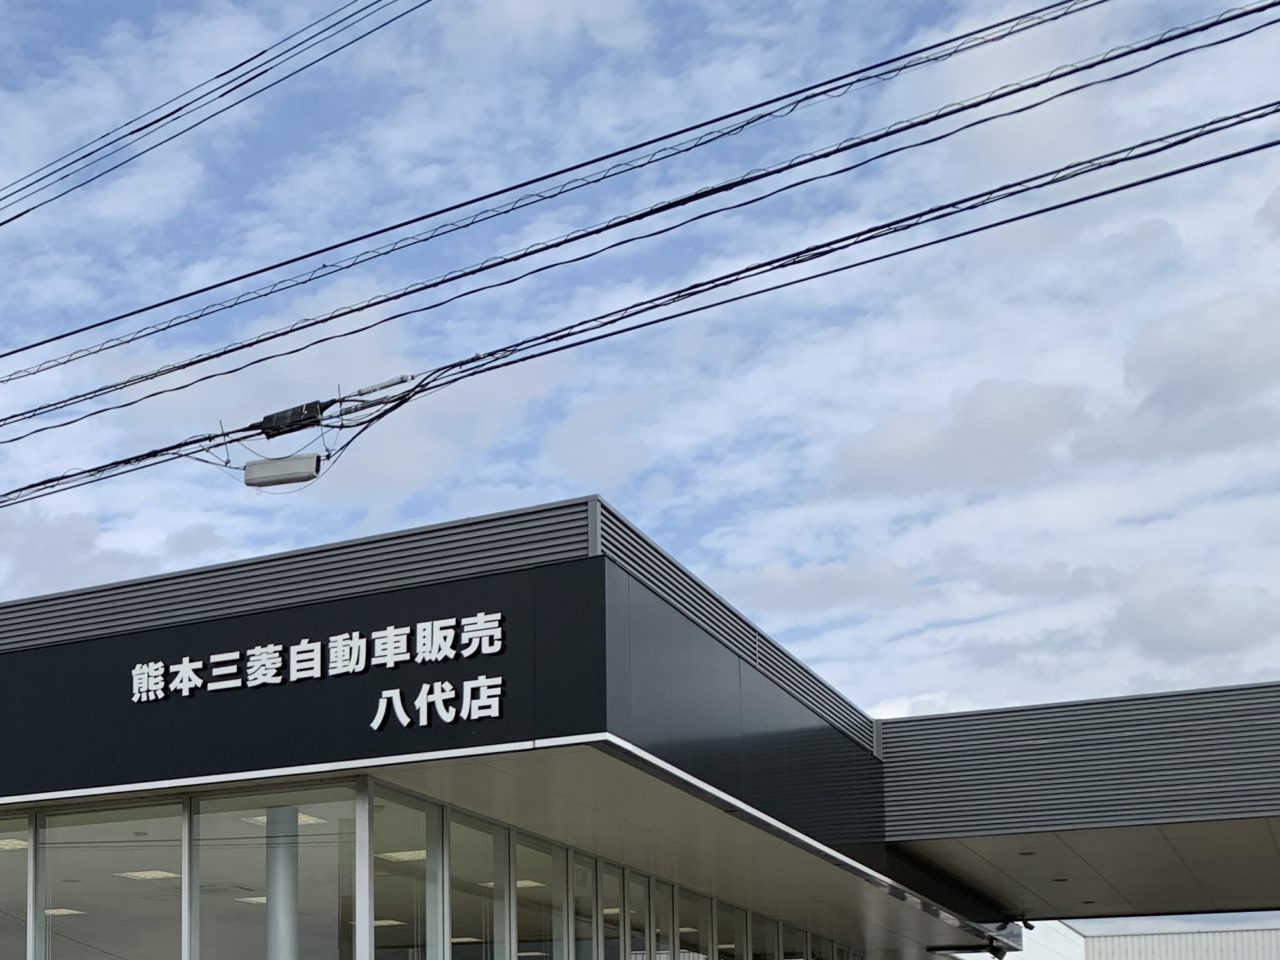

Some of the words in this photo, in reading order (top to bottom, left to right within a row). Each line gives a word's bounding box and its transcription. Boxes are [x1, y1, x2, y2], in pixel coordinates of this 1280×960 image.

[131, 611, 502, 703] 熊本三菱自動車販売
[370, 675, 502, 730] 八代店
